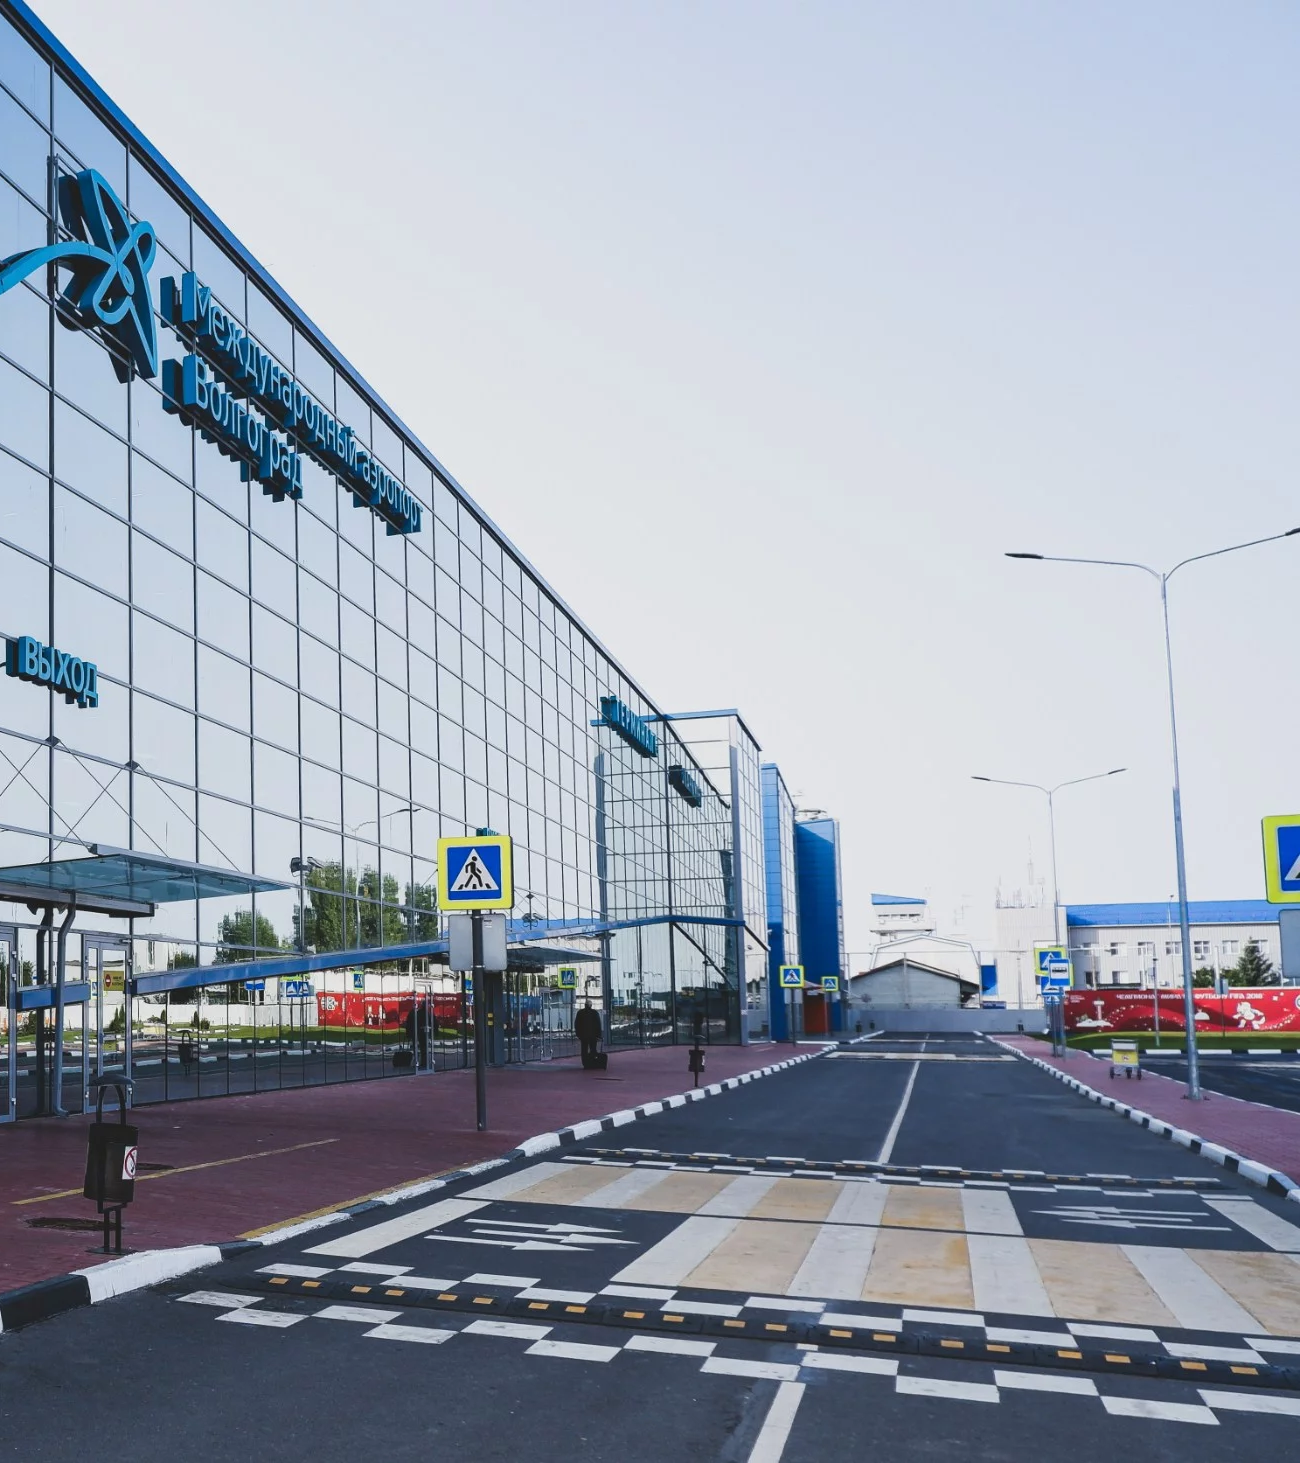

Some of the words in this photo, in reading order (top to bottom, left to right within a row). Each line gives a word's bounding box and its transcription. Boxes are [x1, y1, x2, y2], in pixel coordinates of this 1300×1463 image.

[191, 271, 358, 468] Международный
[362, 455, 424, 532] аэропорт
[191, 354, 303, 498] Волгоград
[22, 636, 98, 707] ВЫХОД
